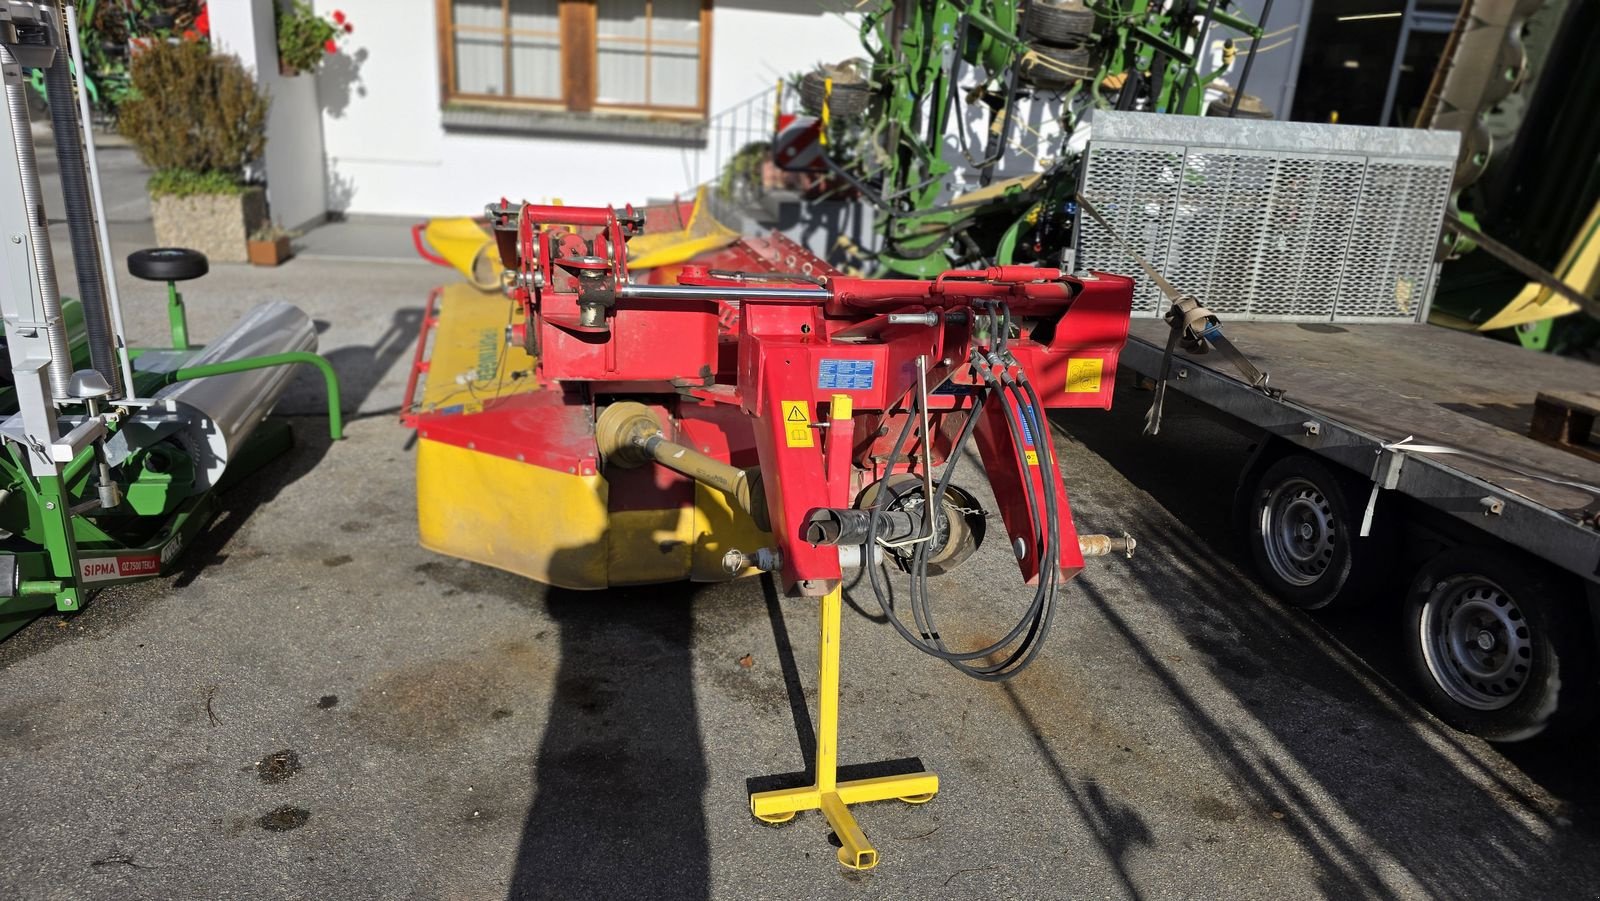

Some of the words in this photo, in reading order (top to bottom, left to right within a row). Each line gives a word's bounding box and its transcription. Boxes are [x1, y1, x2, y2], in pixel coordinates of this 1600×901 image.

[84, 562, 115, 577] SIPMA
[122, 561, 129, 571] OZ
[130, 561, 141, 570] 7500
[142, 560, 155, 569] TEKLA
